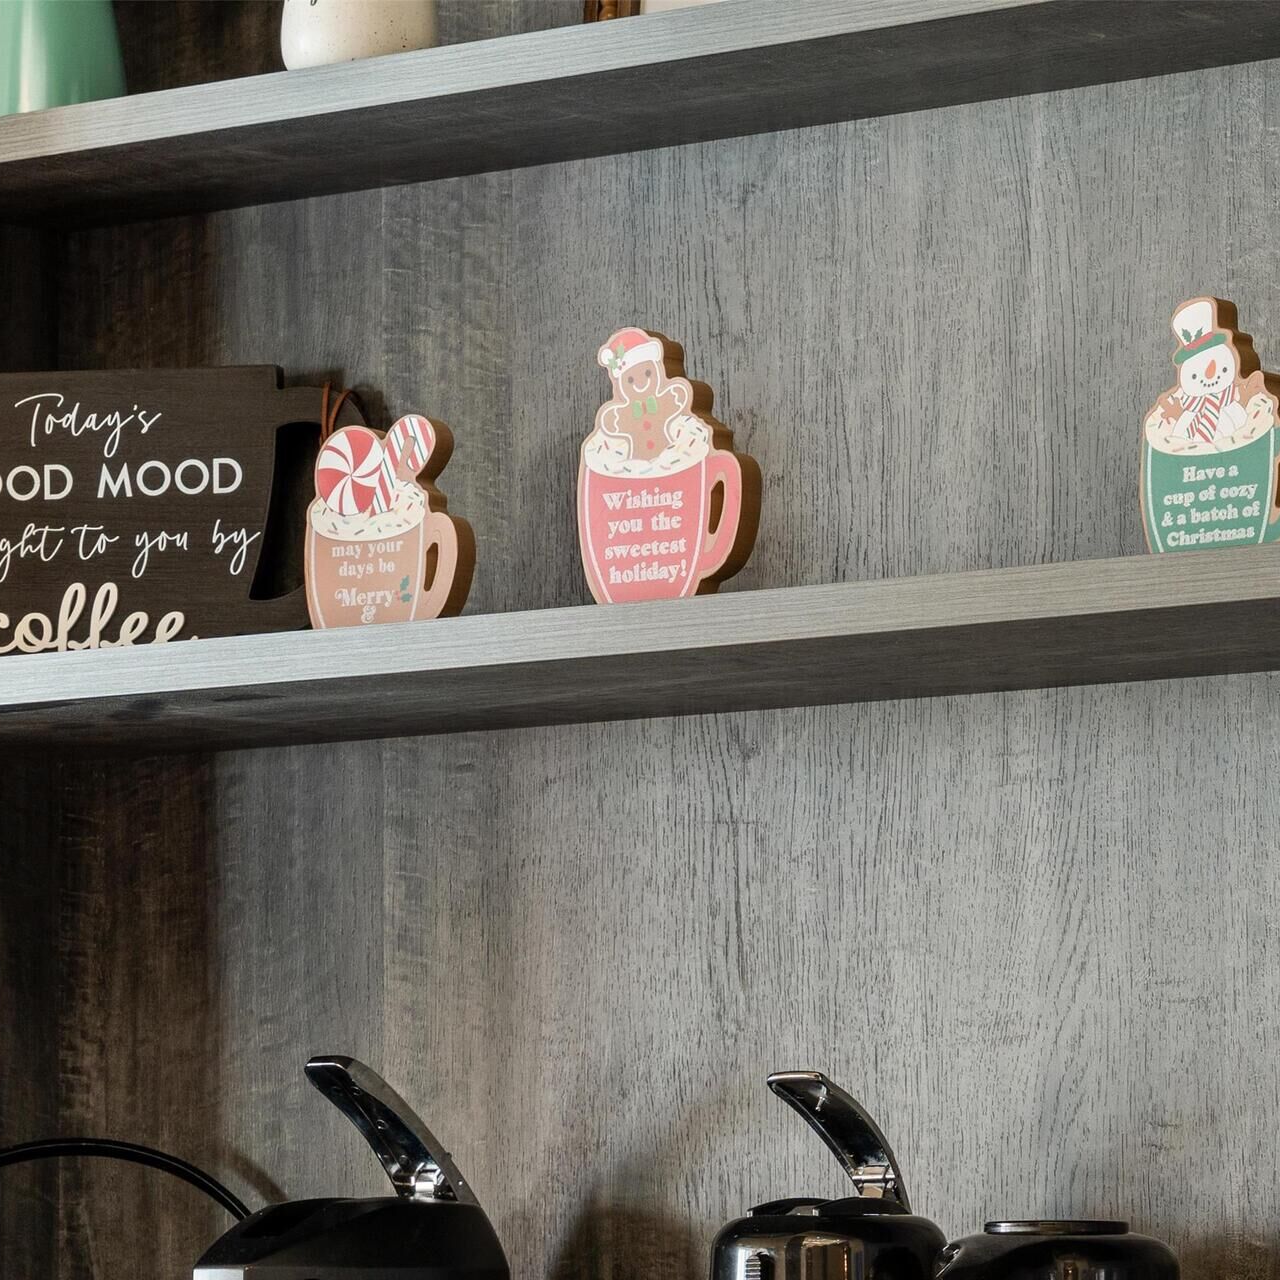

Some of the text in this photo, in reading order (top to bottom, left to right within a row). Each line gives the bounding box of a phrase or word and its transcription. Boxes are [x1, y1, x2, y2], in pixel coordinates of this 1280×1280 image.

[14, 392, 162, 458] Today's
[97, 457, 243, 500] MOOD
[1182, 465, 1239, 482] Have a
[602, 487, 684, 511] Wishing
[1163, 483, 1258, 506] cup of cozy
[1161, 501, 1261, 527] & a batch of
[607, 512, 682, 540] you the
[1166, 526, 1255, 547] Christmas
[70, 525, 119, 561] to
[135, 529, 188, 578] you
[212, 519, 261, 574] by
[331, 540, 404, 559] may your
[604, 538, 687, 560] sweetest
[338, 558, 395, 579] days be
[609, 559, 687, 585] holiday!
[334, 587, 396, 608] Merry
[361, 605, 377, 623] &
